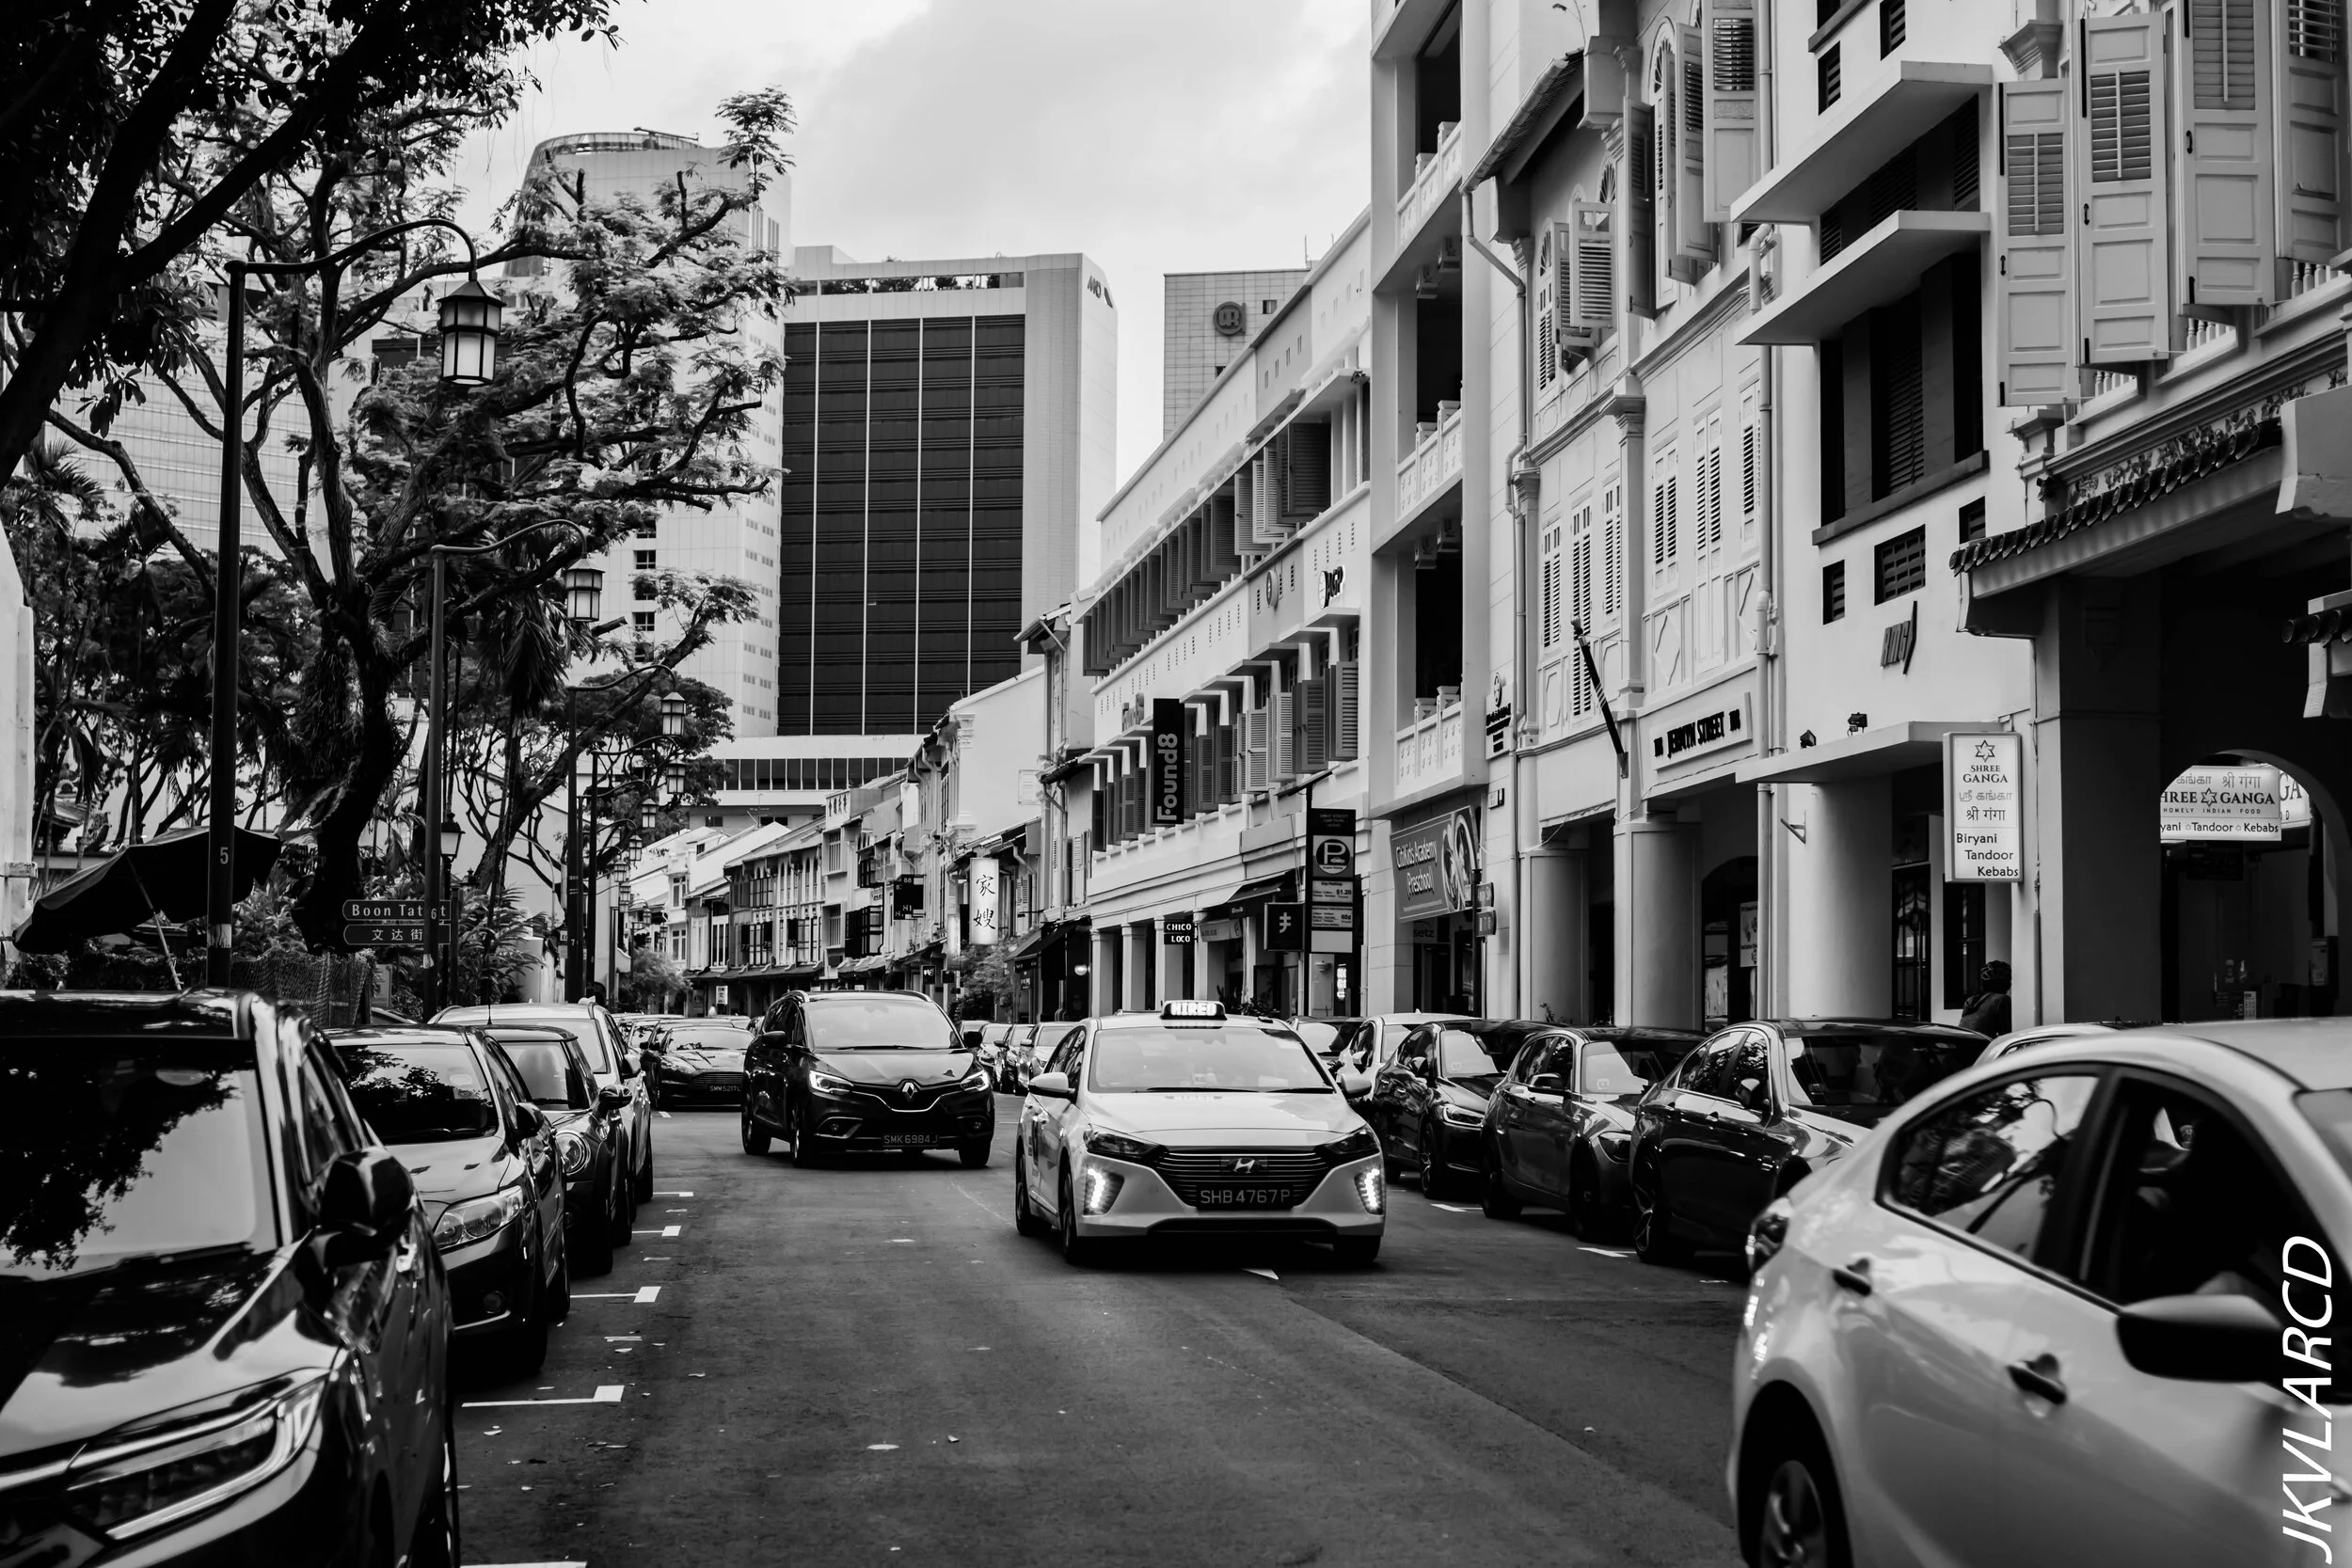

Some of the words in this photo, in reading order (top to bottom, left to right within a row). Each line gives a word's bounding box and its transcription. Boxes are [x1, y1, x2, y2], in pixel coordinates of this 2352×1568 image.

[1697, 711, 1724, 745] STREET
[1970, 765, 2001, 773] SHREE
[1157, 733, 1178, 821] Found8
[1963, 773, 2009, 784] GANGA
[2161, 791, 2198, 803] HREE
[2220, 791, 2276, 805] GANGA
[1982, 807, 2007, 821] गंगा
[2191, 822, 2233, 832] Tandoor
[2244, 822, 2279, 833] Kebabs
[1956, 832, 1997, 846] Biryani
[219, 847, 229, 864] 5
[1964, 849, 2014, 860] Tandoor
[1978, 866, 2019, 877] Kebabs
[973, 874, 996, 930] 家嫂
[352, 903, 391, 917] Boon
[398, 904, 423, 917] Tat
[430, 908, 437, 920] 6
[1166, 923, 1192, 931] CHICO
[372, 928, 423, 942] 文达街
[1170, 935, 1191, 943] LOCO
[1170, 1002, 1217, 1016] HIRED
